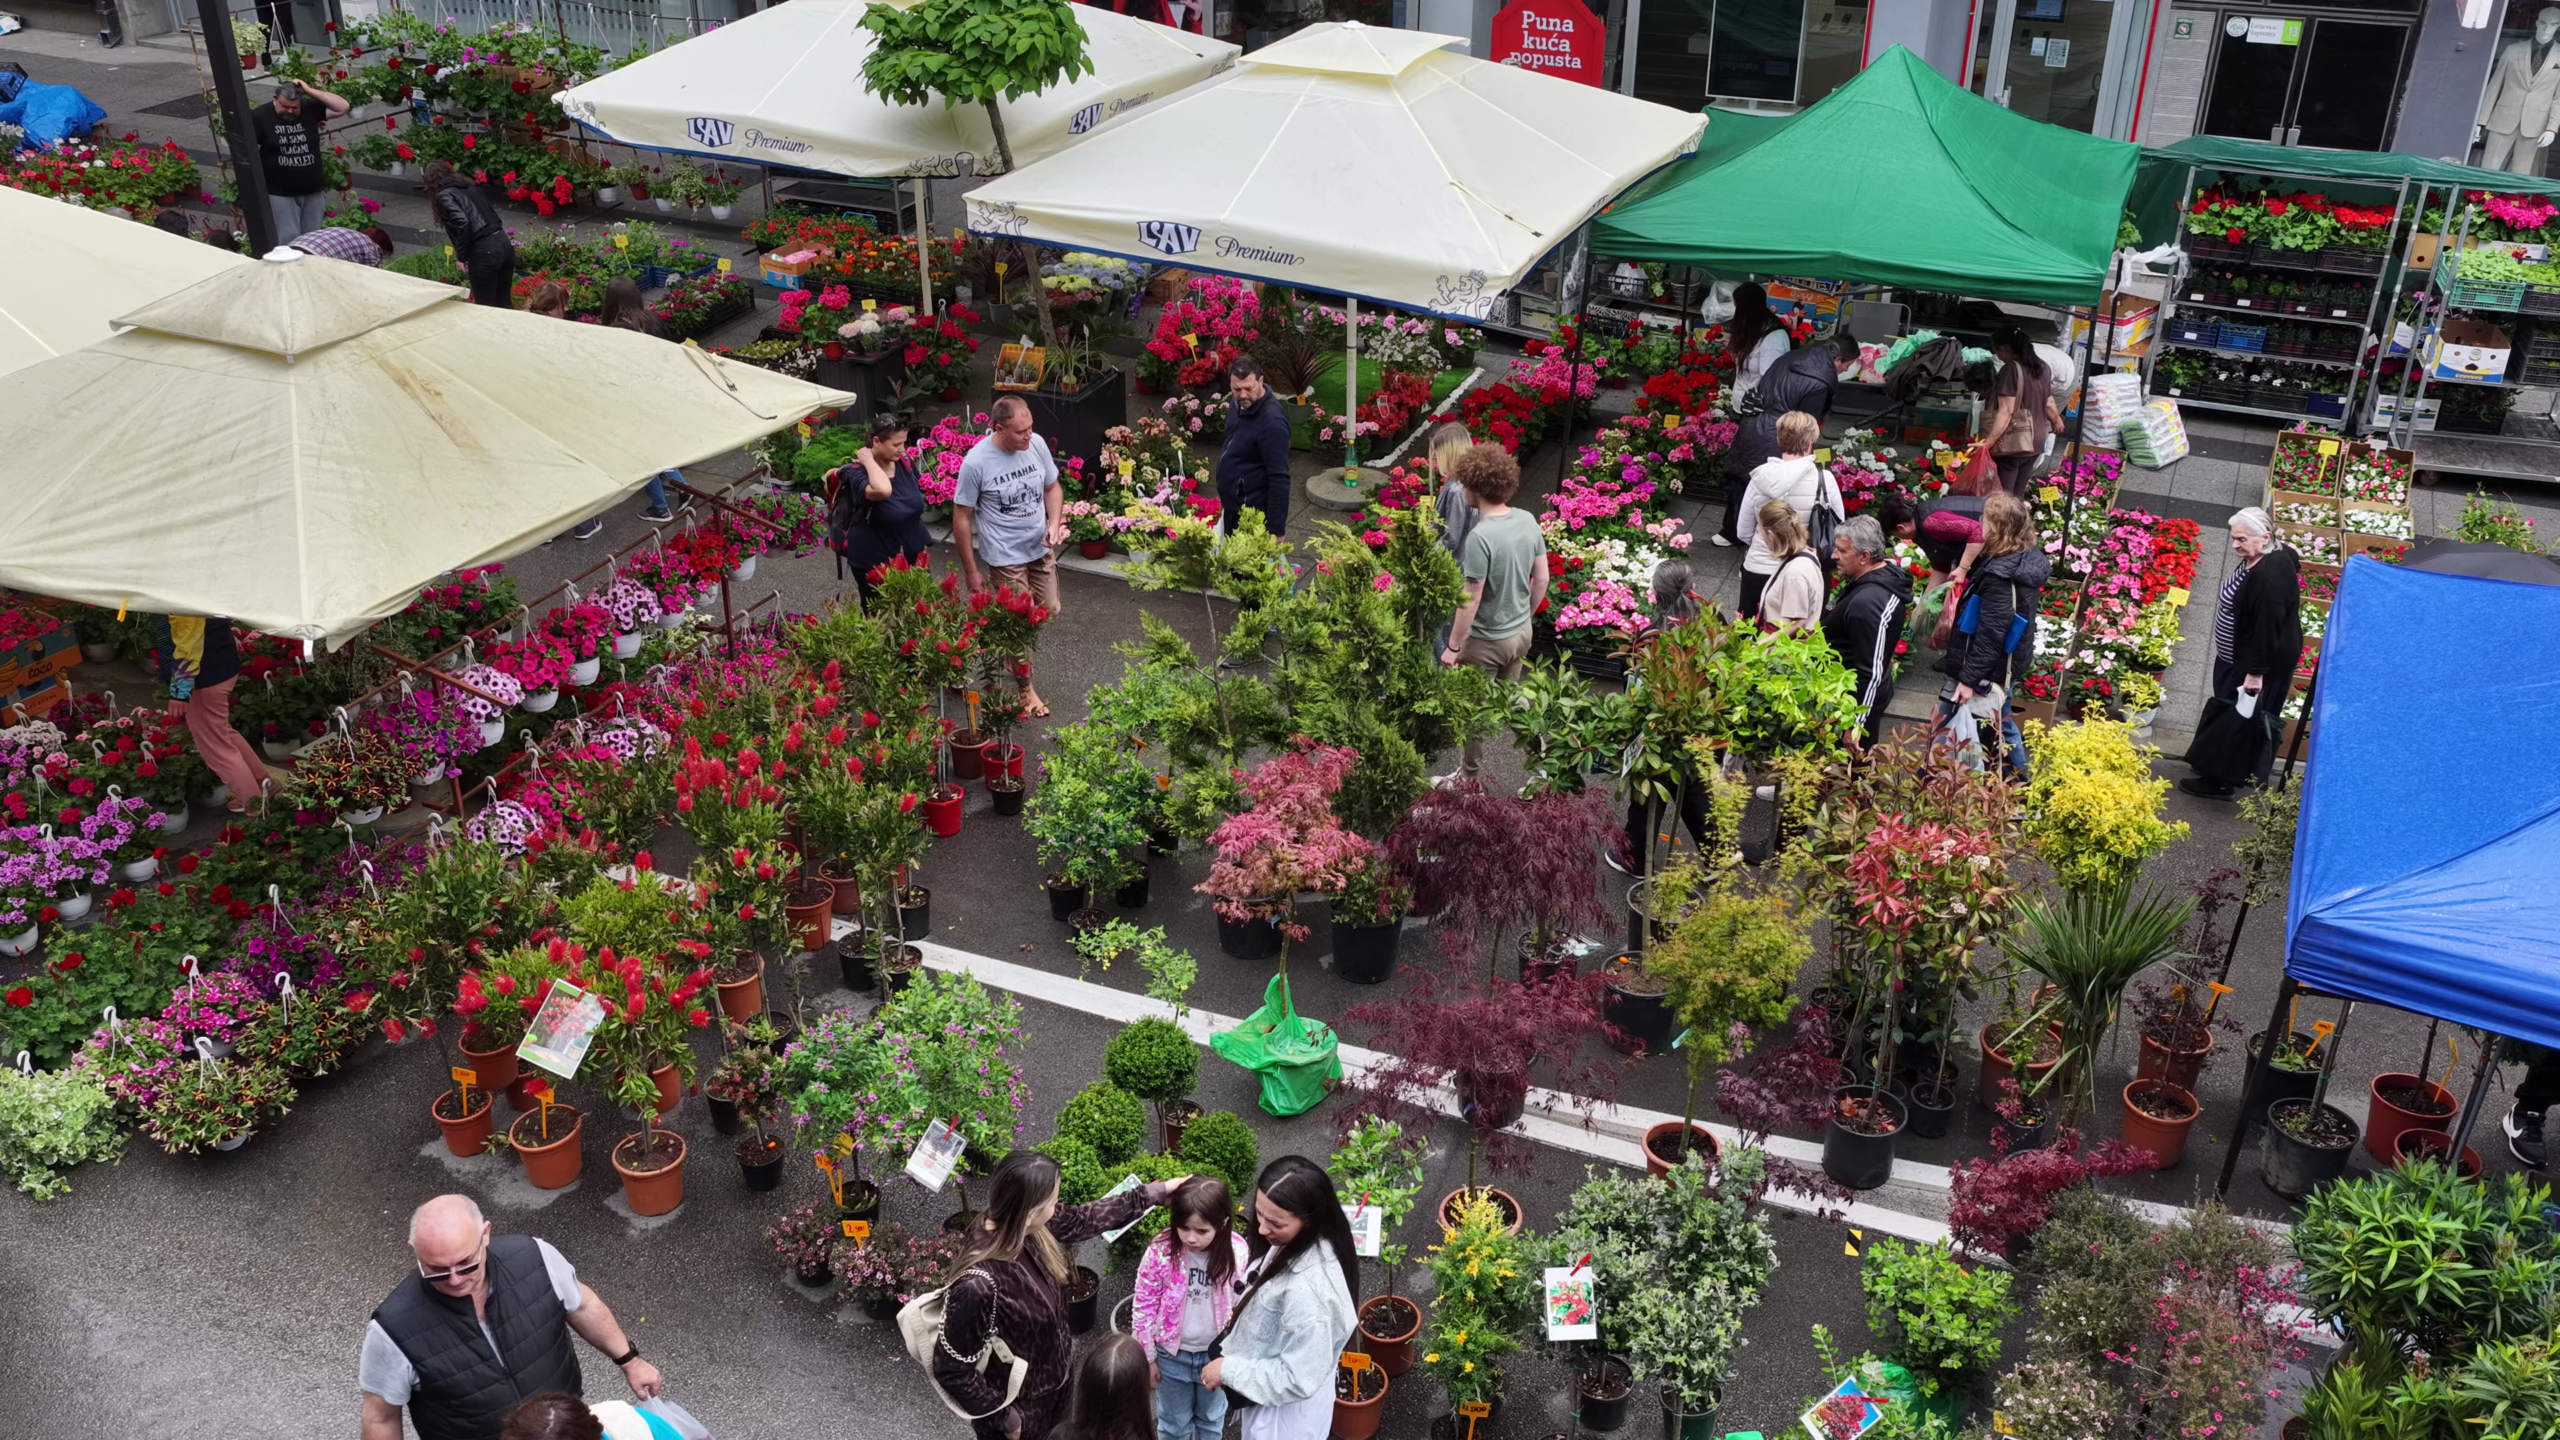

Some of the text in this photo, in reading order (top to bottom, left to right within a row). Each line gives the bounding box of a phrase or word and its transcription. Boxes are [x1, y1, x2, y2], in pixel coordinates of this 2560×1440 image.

[1521, 10, 1574, 32] Puna
[1522, 30, 1571, 52] kuća
[1510, 51, 1582, 69] popusta
[289, 133, 307, 144] SAMO
[744, 128, 814, 154] Premium
[1215, 235, 1306, 266] Premium
[28, 662, 53, 679] toco
